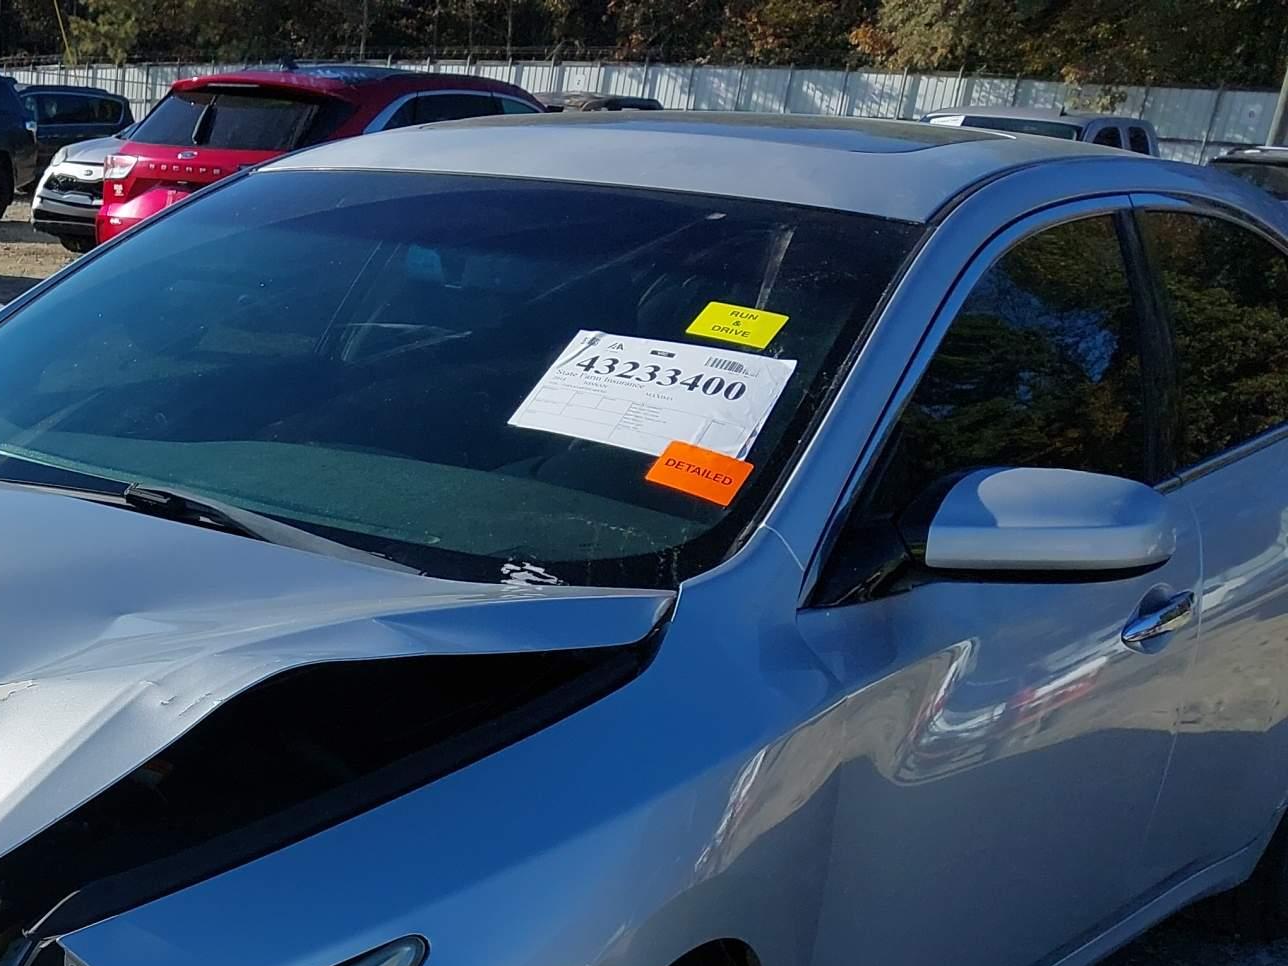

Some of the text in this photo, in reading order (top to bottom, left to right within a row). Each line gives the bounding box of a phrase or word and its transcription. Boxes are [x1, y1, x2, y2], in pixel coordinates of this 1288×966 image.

[730, 310, 759, 321] RUN
[711, 324, 752, 338] DRIVE
[576, 355, 747, 401] 43233400
[664, 458, 733, 486] DETAILED
